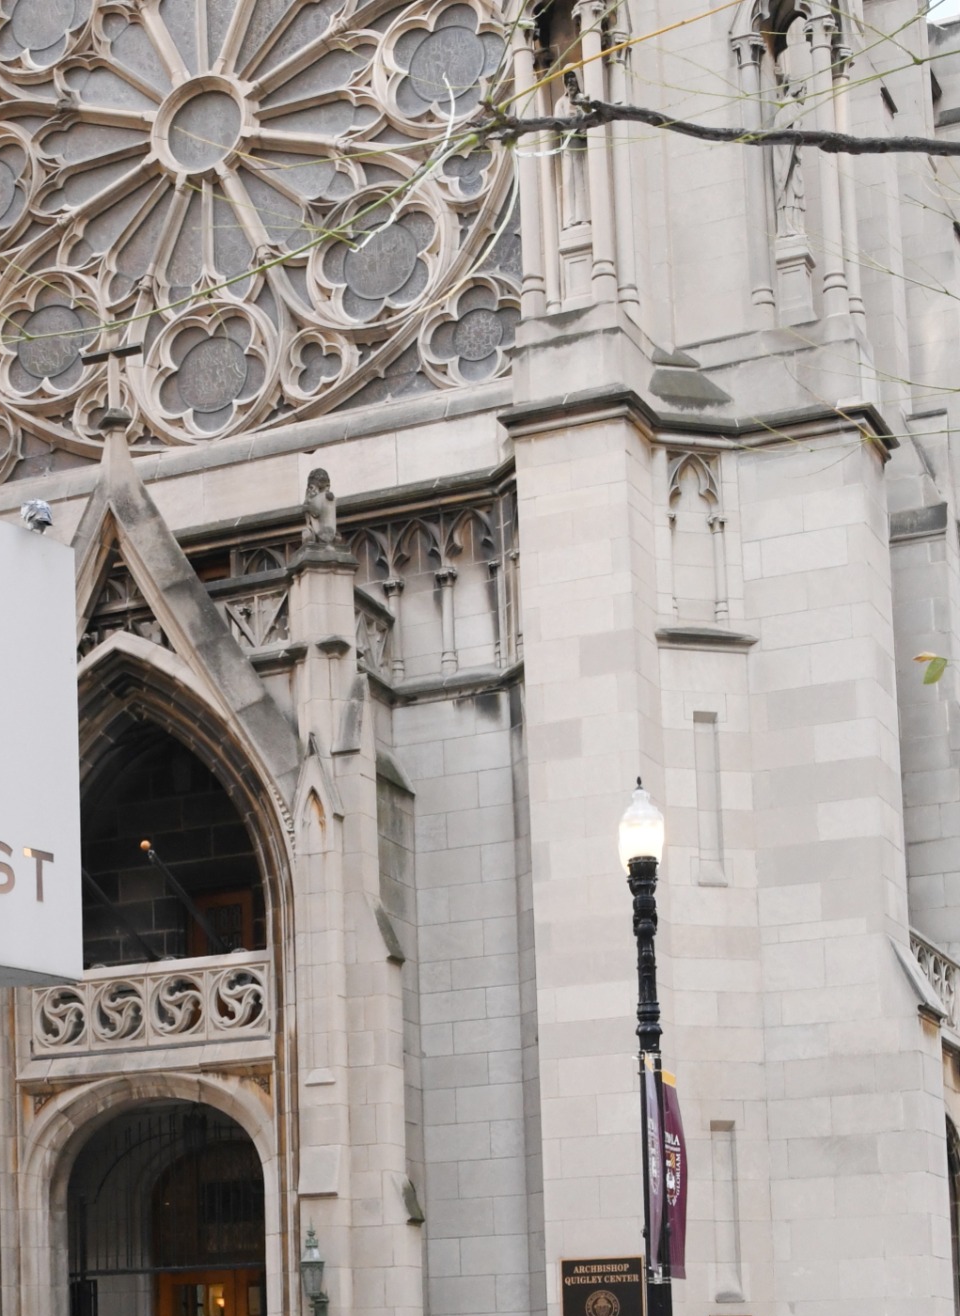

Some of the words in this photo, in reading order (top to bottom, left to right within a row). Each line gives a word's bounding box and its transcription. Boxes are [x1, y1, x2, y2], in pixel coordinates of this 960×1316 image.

[573, 1263, 629, 1274] ARCHBISHOP
[564, 1275, 603, 1286] QUIGLEY
[604, 1274, 639, 1283] CENTER
